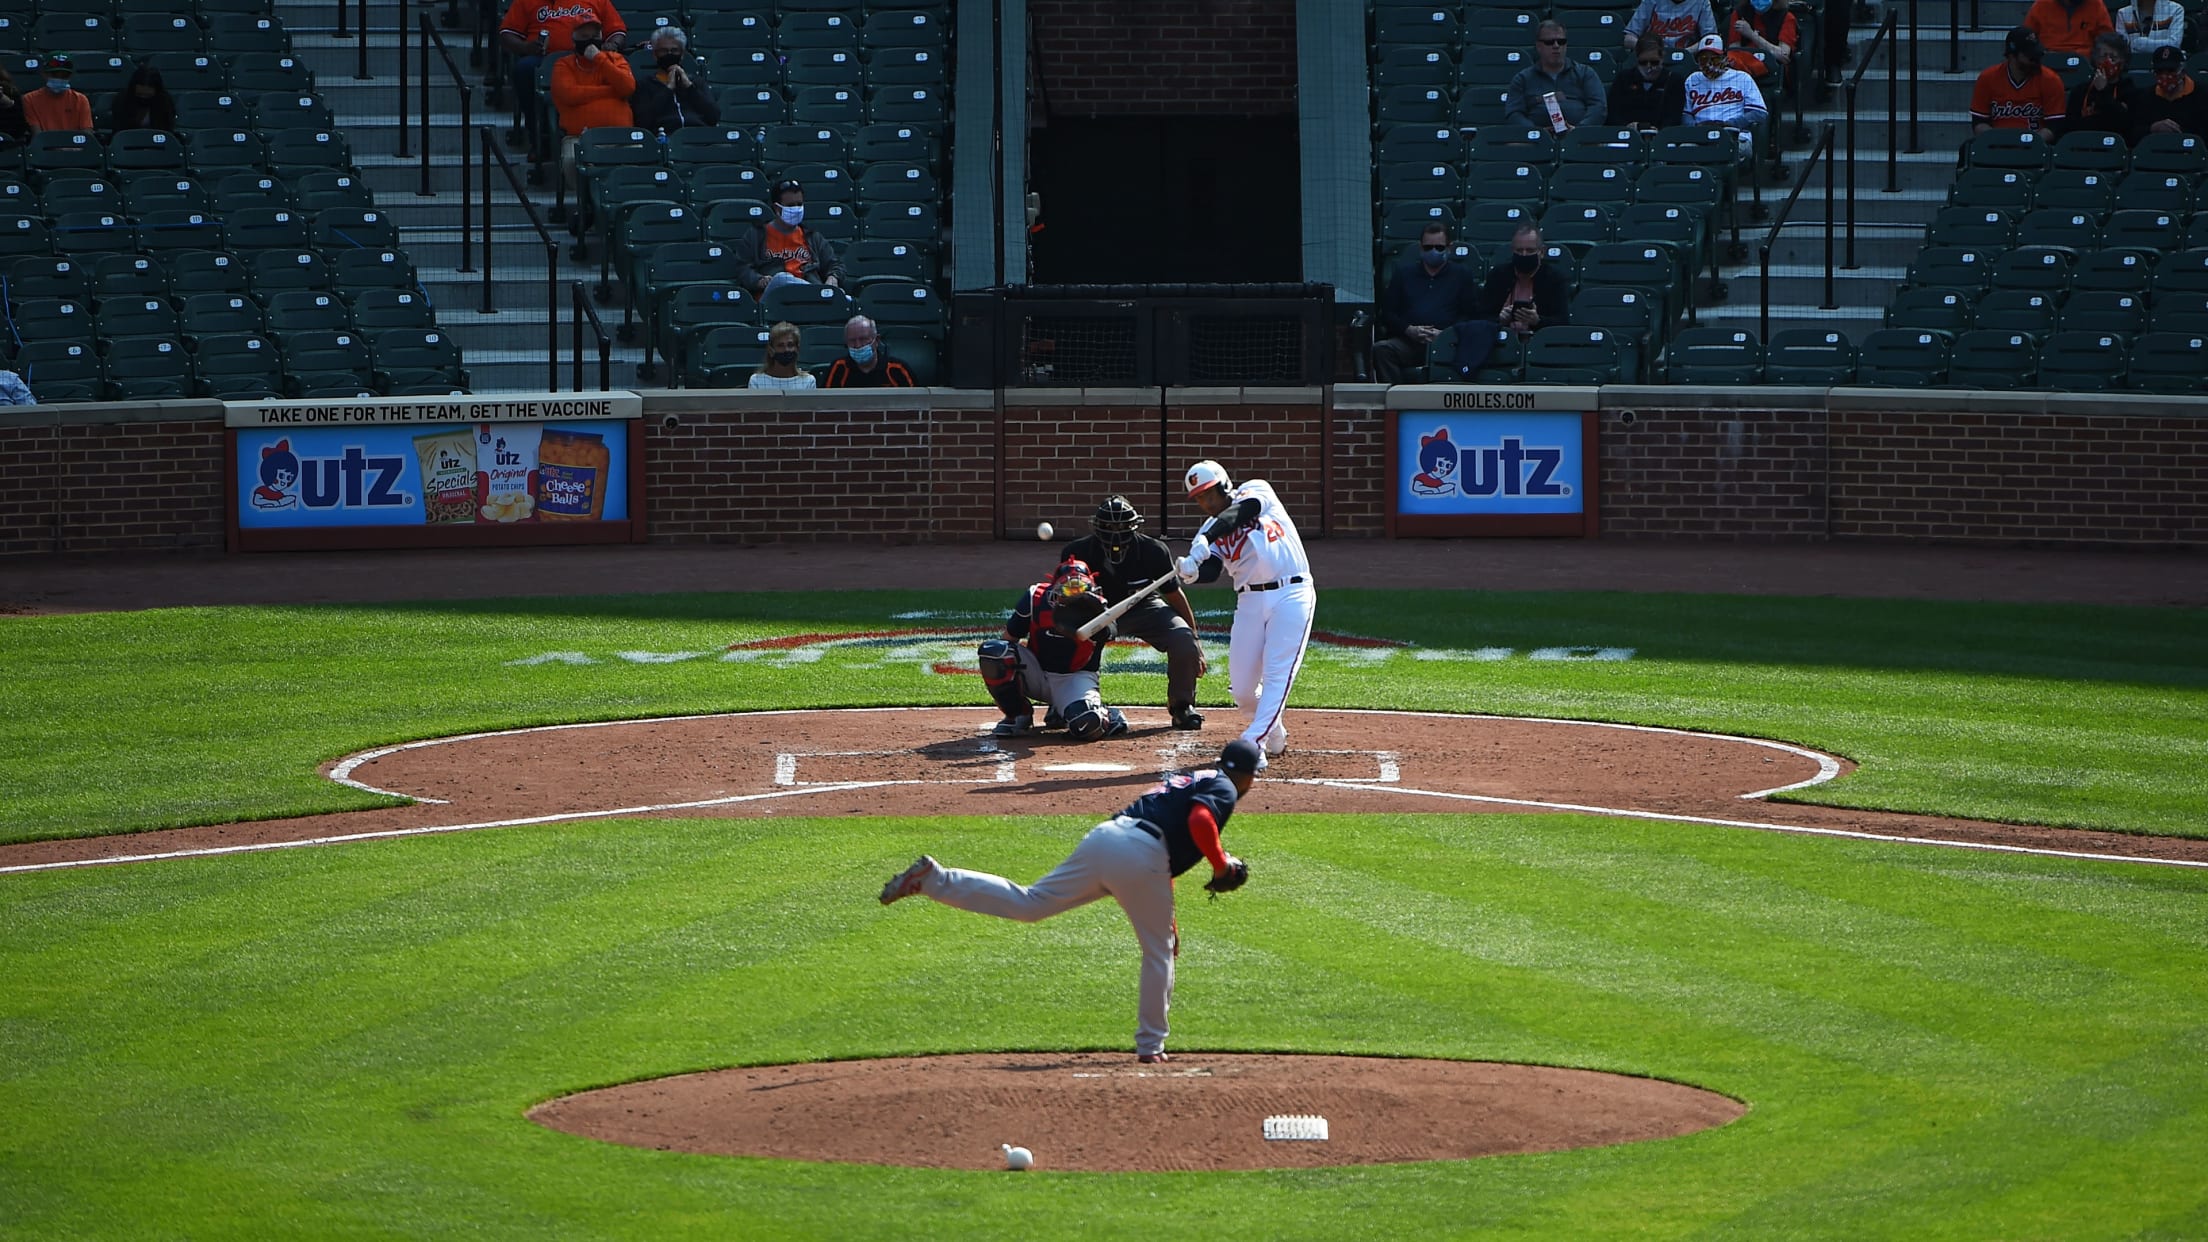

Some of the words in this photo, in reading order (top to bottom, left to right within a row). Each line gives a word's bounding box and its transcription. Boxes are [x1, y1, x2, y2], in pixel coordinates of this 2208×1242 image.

[1444, 393, 1535, 409] ORIOLES.COM
[258, 408, 302, 423] TAKE
[306, 407, 339, 422] ONE
[343, 406, 375, 421] FOR
[379, 406, 412, 421] THE
[416, 404, 466, 420] TEAM,
[470, 404, 502, 419] GET
[506, 402, 538, 417] THE
[542, 401, 611, 416] VACCINE
[441, 458, 460, 469] utz
[496, 451, 520, 466] utz
[490, 467, 528, 483] Original
[1461, 439, 1561, 495] utz
[302, 448, 403, 507] utz
[427, 470, 477, 496] Specials
[546, 480, 585, 493] Cheese
[552, 493, 579, 505] Balls
